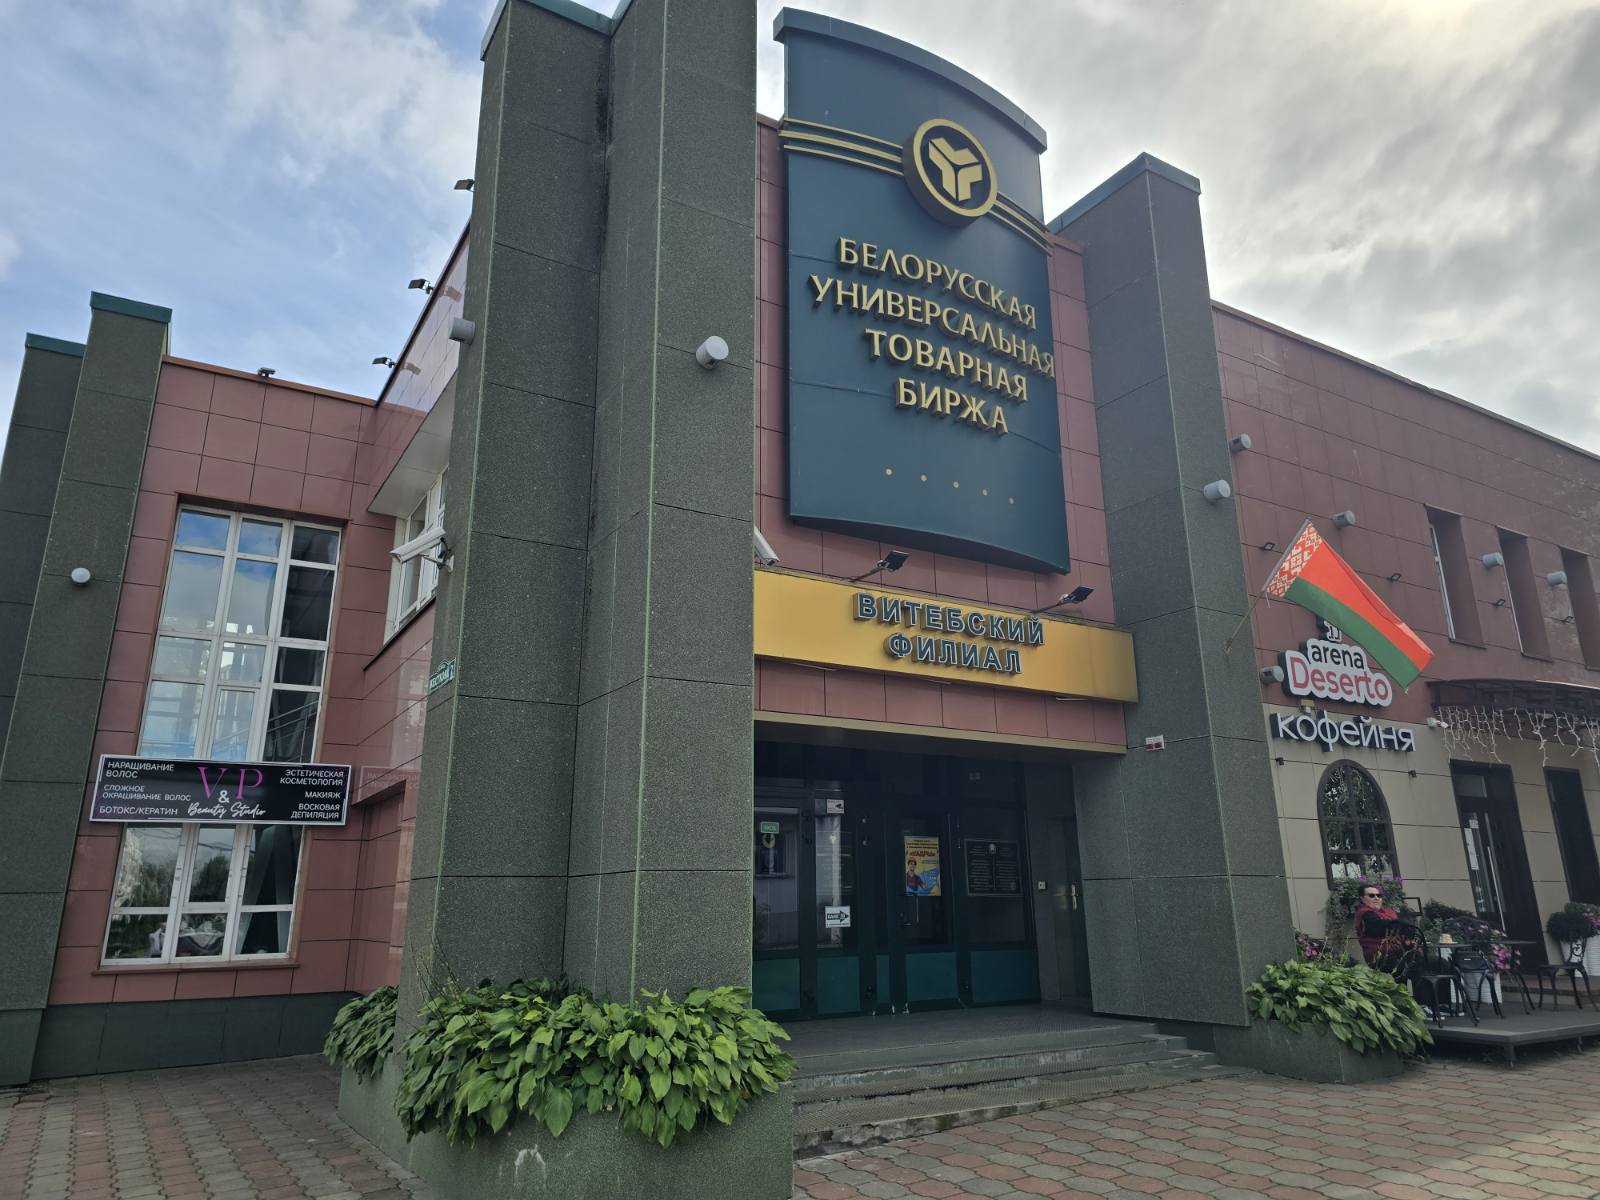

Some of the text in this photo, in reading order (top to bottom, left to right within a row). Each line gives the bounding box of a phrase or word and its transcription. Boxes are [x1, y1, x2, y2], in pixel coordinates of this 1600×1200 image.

[838, 236, 1036, 330] БЕЛОРУССКАЯ
[809, 274, 1055, 378] УНИВЕРСАЛЬНАЯ
[865, 328, 1028, 401] ТОВАРНАЯ
[897, 377, 1008, 434] БИРЖА
[855, 591, 1045, 646] ВИТЕБСКИЙ
[886, 632, 1022, 674] ФИЛИАЛ
[1311, 644, 1365, 670] arena
[1290, 656, 1389, 701] Deserto
[1274, 710, 1416, 752] кофейня
[105, 769, 139, 779] ВОЛОС
[107, 761, 175, 772] НАРАЩИВАНИЕ
[285, 769, 344, 779] ЭСТЕТИЧЕСКАЯ
[103, 784, 145, 793] СЛОЖНОЕ
[198, 766, 263, 800] V P
[279, 777, 344, 787] КОСМЕТОЛОГИЯ
[102, 791, 192, 802] ОКРАШИВАНИЕ ВОЛОС
[217, 789, 230, 804] &
[304, 791, 341, 800] МАКИЯЖ
[99, 805, 178, 816] БОТОКС/КЕРАТИН
[187, 801, 267, 819] Beauty Studio
[290, 810, 340, 820] ДЕПИЛЯЦИЯ
[298, 803, 341, 812] ВОСКОВАЯ
